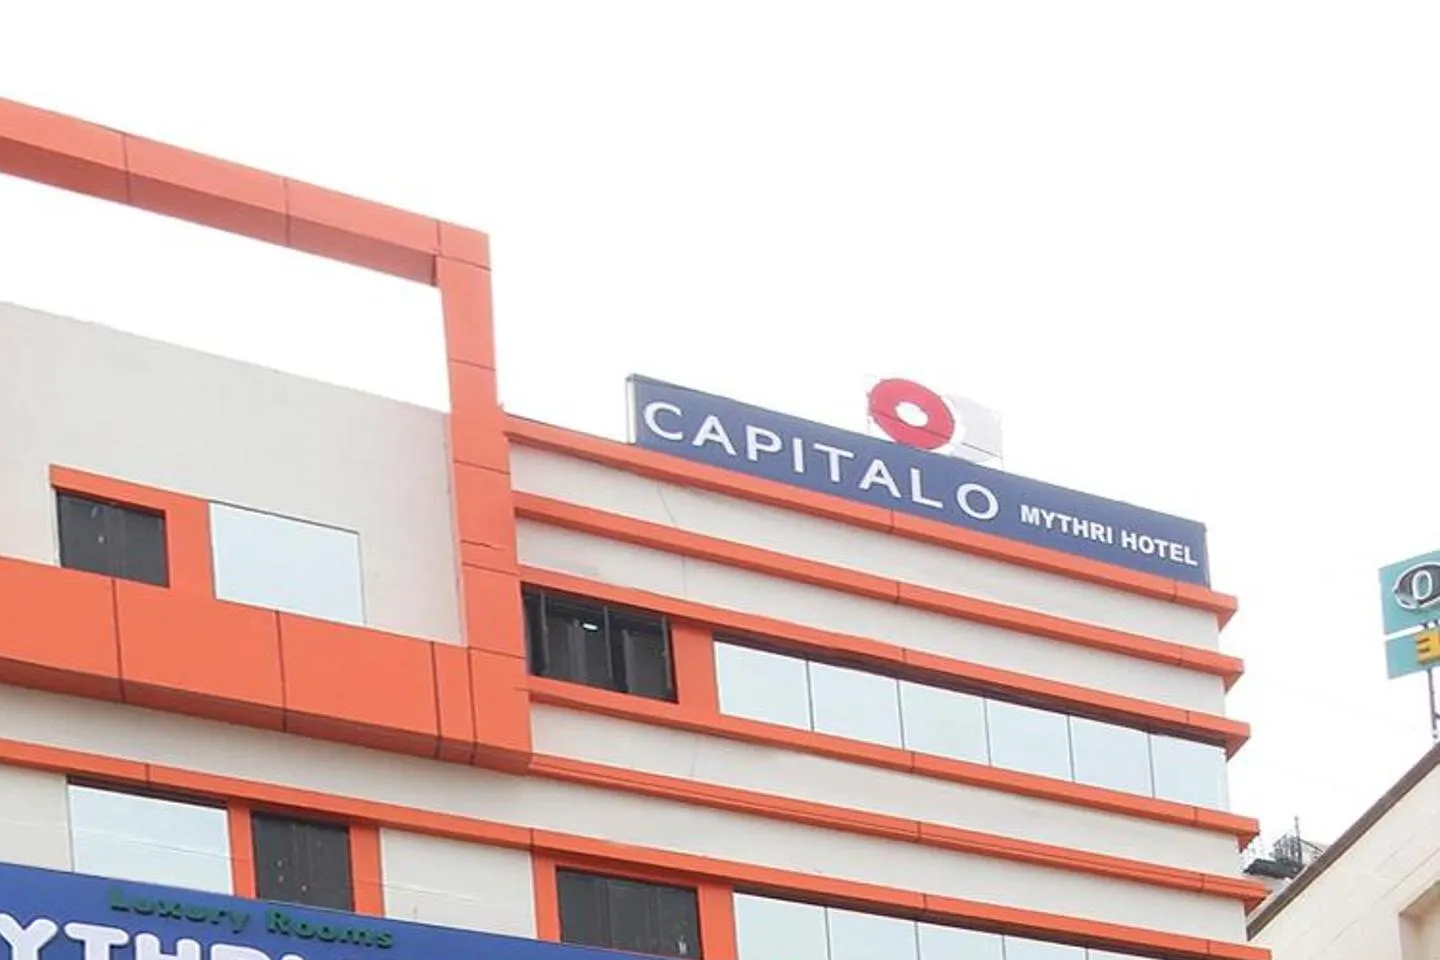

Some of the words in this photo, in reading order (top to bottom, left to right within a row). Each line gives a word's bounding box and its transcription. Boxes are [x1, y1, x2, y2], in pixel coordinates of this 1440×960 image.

[1020, 503, 1114, 545] MYTHRI
[1120, 530, 1199, 567] HOTEL
[109, 886, 251, 934] Luxury
[265, 908, 393, 949] Rooms
